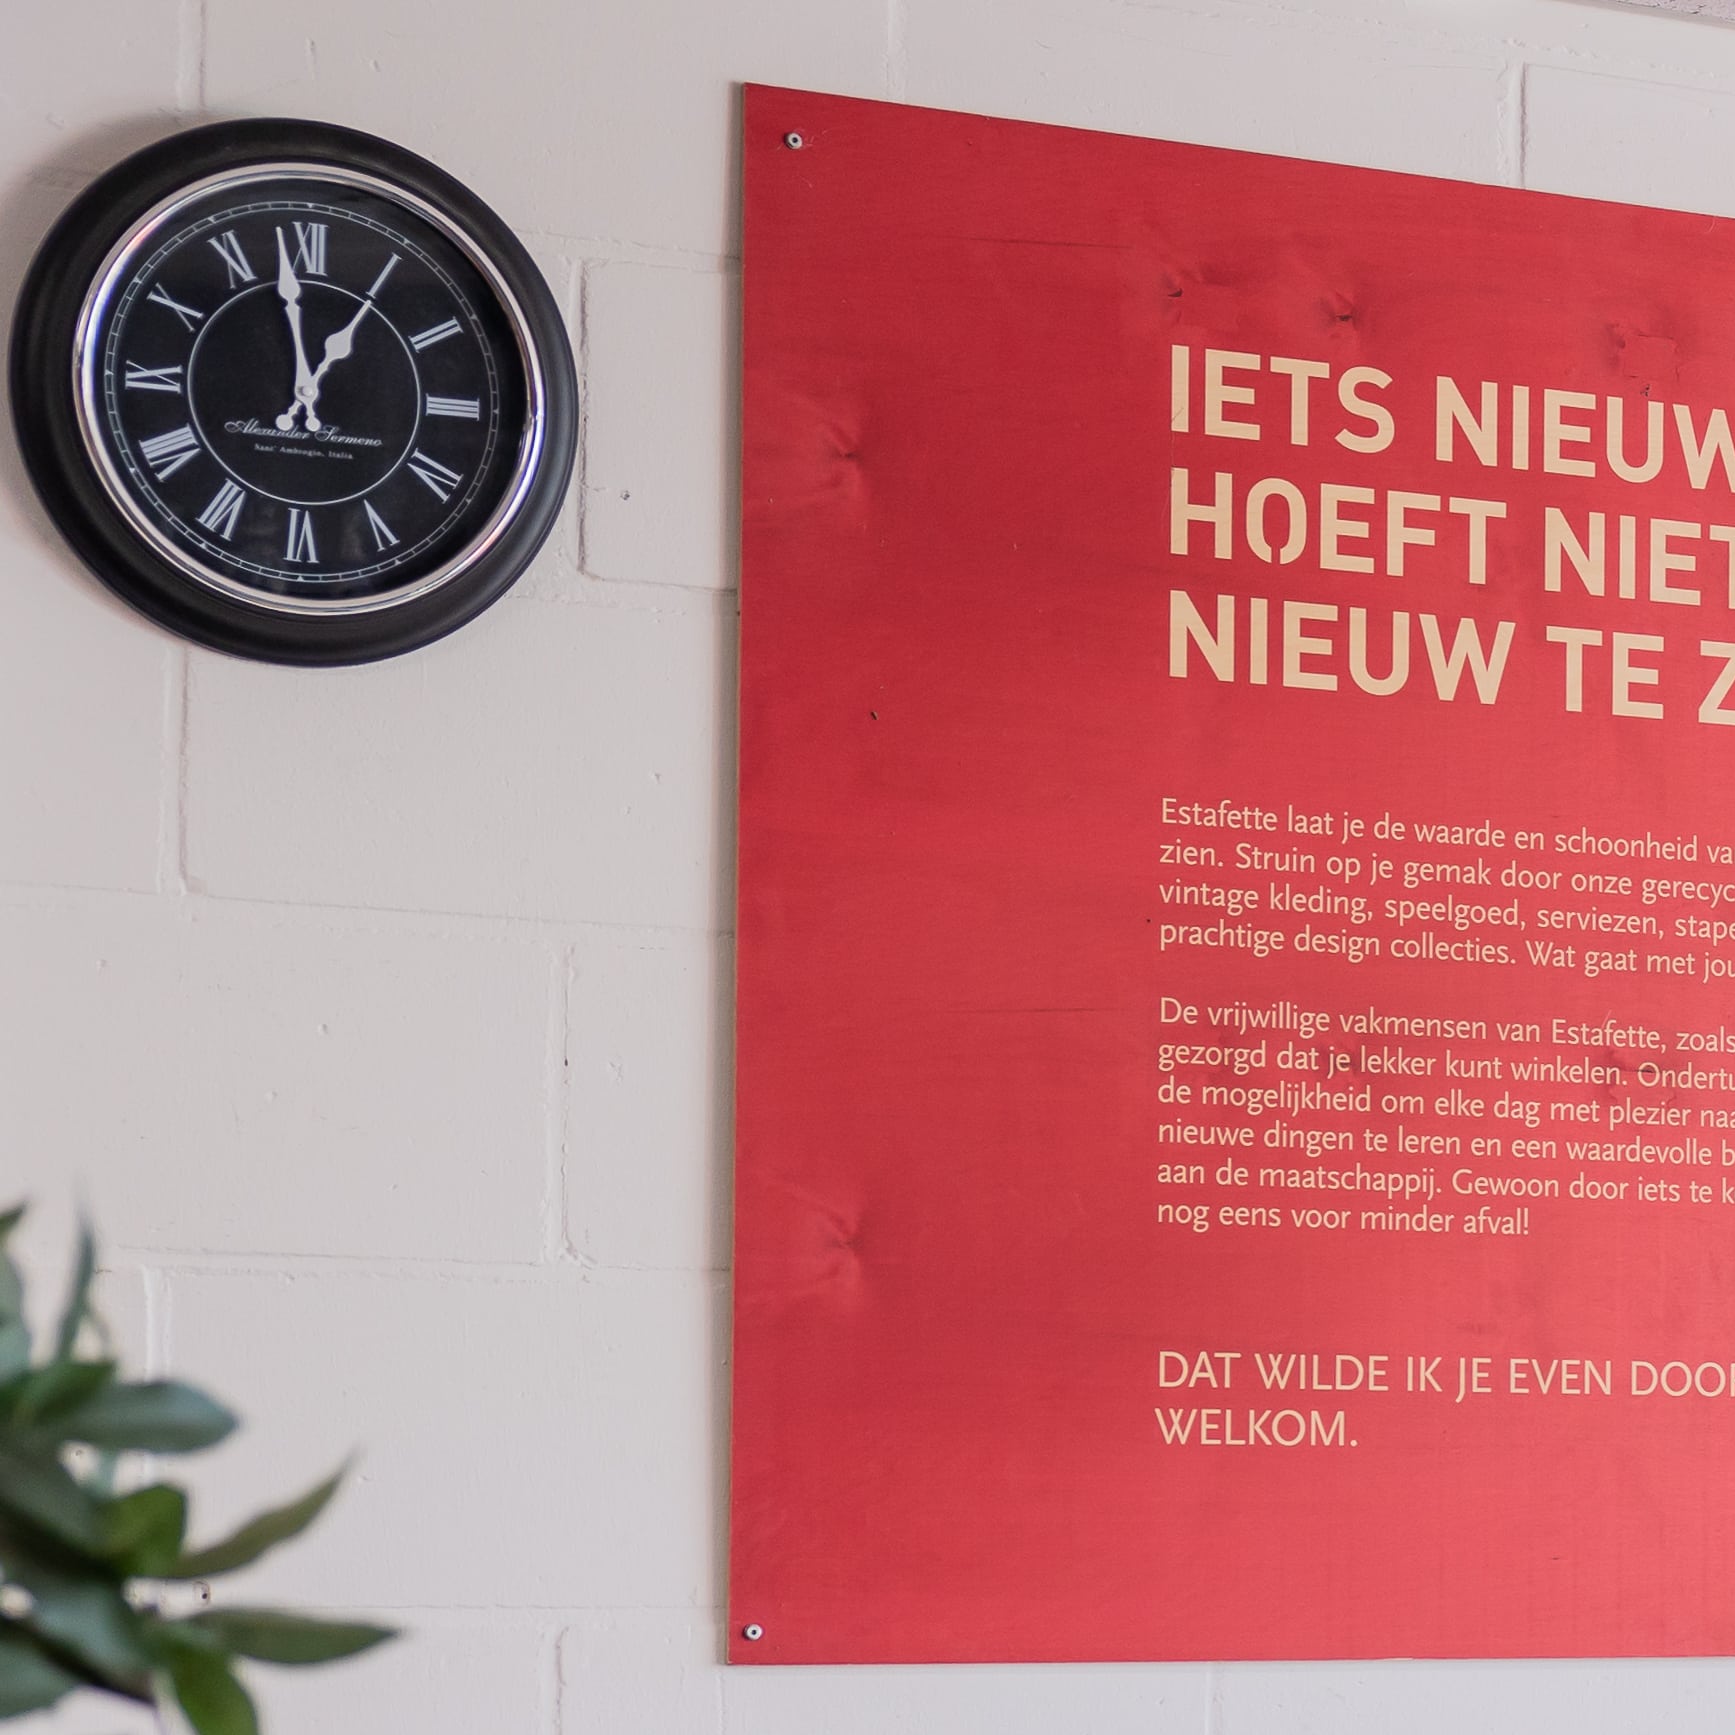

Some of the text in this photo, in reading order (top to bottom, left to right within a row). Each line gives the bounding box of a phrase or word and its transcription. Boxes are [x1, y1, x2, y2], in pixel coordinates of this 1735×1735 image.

[207, 229, 256, 289] XI
[292, 221, 328, 276] XII
[366, 253, 402, 298] I
[147, 283, 203, 332] X
[408, 317, 463, 353] II
[426, 394, 479, 421] III
[1171, 345, 1395, 453] IETS
[224, 418, 310, 440] Alexander
[1171, 467, 1507, 584] HOEFT
[1169, 590, 1516, 704] NIEUW
[1546, 626, 1664, 719] TE
[1162, 797, 1278, 831] Estafette
[1288, 805, 1334, 835] laat
[1342, 812, 1364, 844] je
[1374, 812, 1405, 840] de
[1414, 820, 1505, 847] waarde
[1514, 831, 1544, 850] en
[1555, 827, 1697, 861] schoonheid
[1160, 839, 1223, 867] zien.
[1236, 843, 1315, 873] Struin
[1327, 857, 1361, 883] op
[1370, 853, 1393, 885] je
[1404, 858, 1491, 888] gemak
[1501, 860, 1562, 889] door
[1571, 874, 1632, 895] onze
[1159, 879, 1259, 916] vintage
[1270, 882, 1372, 924] kleding,
[1385, 895, 1525, 930] speelgoed,
[1537, 907, 1663, 939] serviezen,
[1160, 919, 1284, 957] prachtige
[1294, 924, 1379, 963] design
[1391, 932, 1515, 964] collecties.
[1526, 941, 1576, 967] Wat
[1585, 950, 1637, 977] gaat
[1647, 954, 1695, 975] met
[1161, 997, 1198, 1024] De
[1208, 1001, 1330, 1039] vrijwillige
[1340, 1007, 1486, 1039] vakmensen
[1497, 1024, 1540, 1042] van
[1552, 1019, 1666, 1053] Estafette,
[1158, 1040, 1266, 1075] gezorgd
[1277, 1041, 1319, 1070] dat
[1328, 1046, 1350, 1079] je
[1361, 1045, 1436, 1075] lekker
[1446, 1050, 1502, 1079] kunt
[1511, 1056, 1627, 1085] winkelen.
[1158, 1075, 1191, 1104] de
[1202, 1081, 1370, 1117] mogelijkheid
[1381, 1095, 1424, 1114] om
[1435, 1089, 1484, 1117] elke
[1494, 1091, 1540, 1128] dag
[1551, 1101, 1600, 1122] met
[1610, 1097, 1691, 1131] plezier
[1159, 1118, 1254, 1146] nieuwe
[1264, 1120, 1353, 1157] dingen
[1364, 1129, 1388, 1152] te
[1399, 1125, 1460, 1154] leren
[1471, 1138, 1501, 1156] en
[1512, 1139, 1556, 1158] een
[1566, 1136, 1712, 1165] waardevolle
[1158, 1164, 1205, 1184] aan
[1216, 1158, 1248, 1185] de
[1260, 1163, 1441, 1200] maatschappij.
[1452, 1169, 1559, 1197] Gewoon
[1569, 1172, 1629, 1199] door
[1638, 1177, 1680, 1202] iets
[1690, 1181, 1712, 1203] te
[1158, 1204, 1528, 1235] nog eens voor minder afval!
[1159, 1351, 1241, 1388] DAT
[1254, 1353, 1389, 1391] WILDE
[1407, 1356, 1442, 1392] IK
[1455, 1357, 1492, 1403] JE
[1510, 1358, 1611, 1395] EVEN
[1155, 1408, 1358, 1447] WELKOM.
